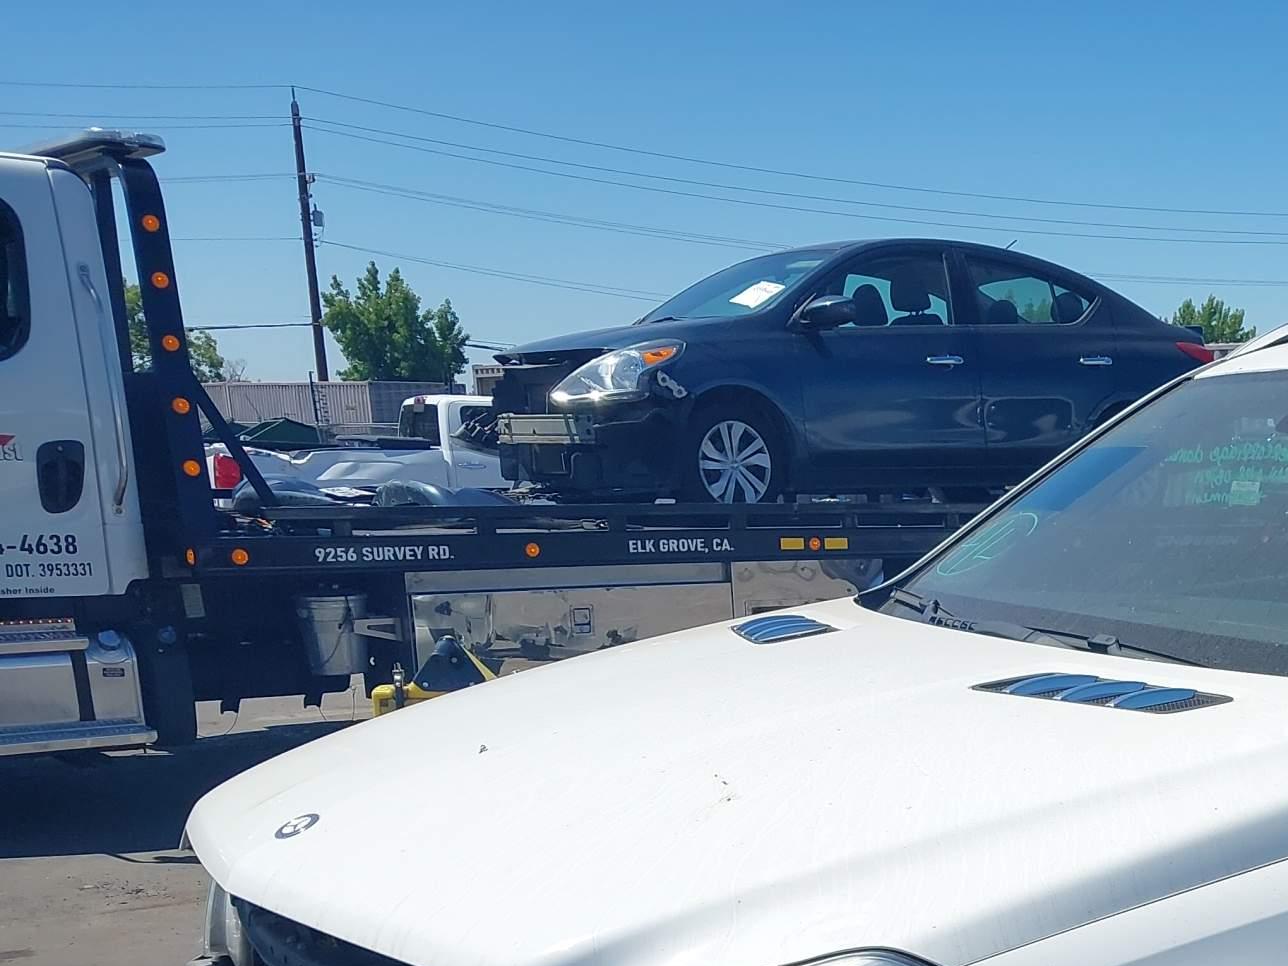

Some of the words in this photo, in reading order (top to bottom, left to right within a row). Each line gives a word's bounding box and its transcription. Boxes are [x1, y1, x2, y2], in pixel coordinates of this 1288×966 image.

[314, 547, 357, 562] 9256
[362, 546, 424, 561] SURVEY
[428, 545, 455, 560] RD.
[628, 540, 656, 553] ELK
[659, 539, 709, 554] GROVE,
[712, 538, 735, 551] CA.
[5, 563, 35, 578] DOT.
[38, 562, 93, 577] 3953331
[25, 585, 55, 594] Inside
